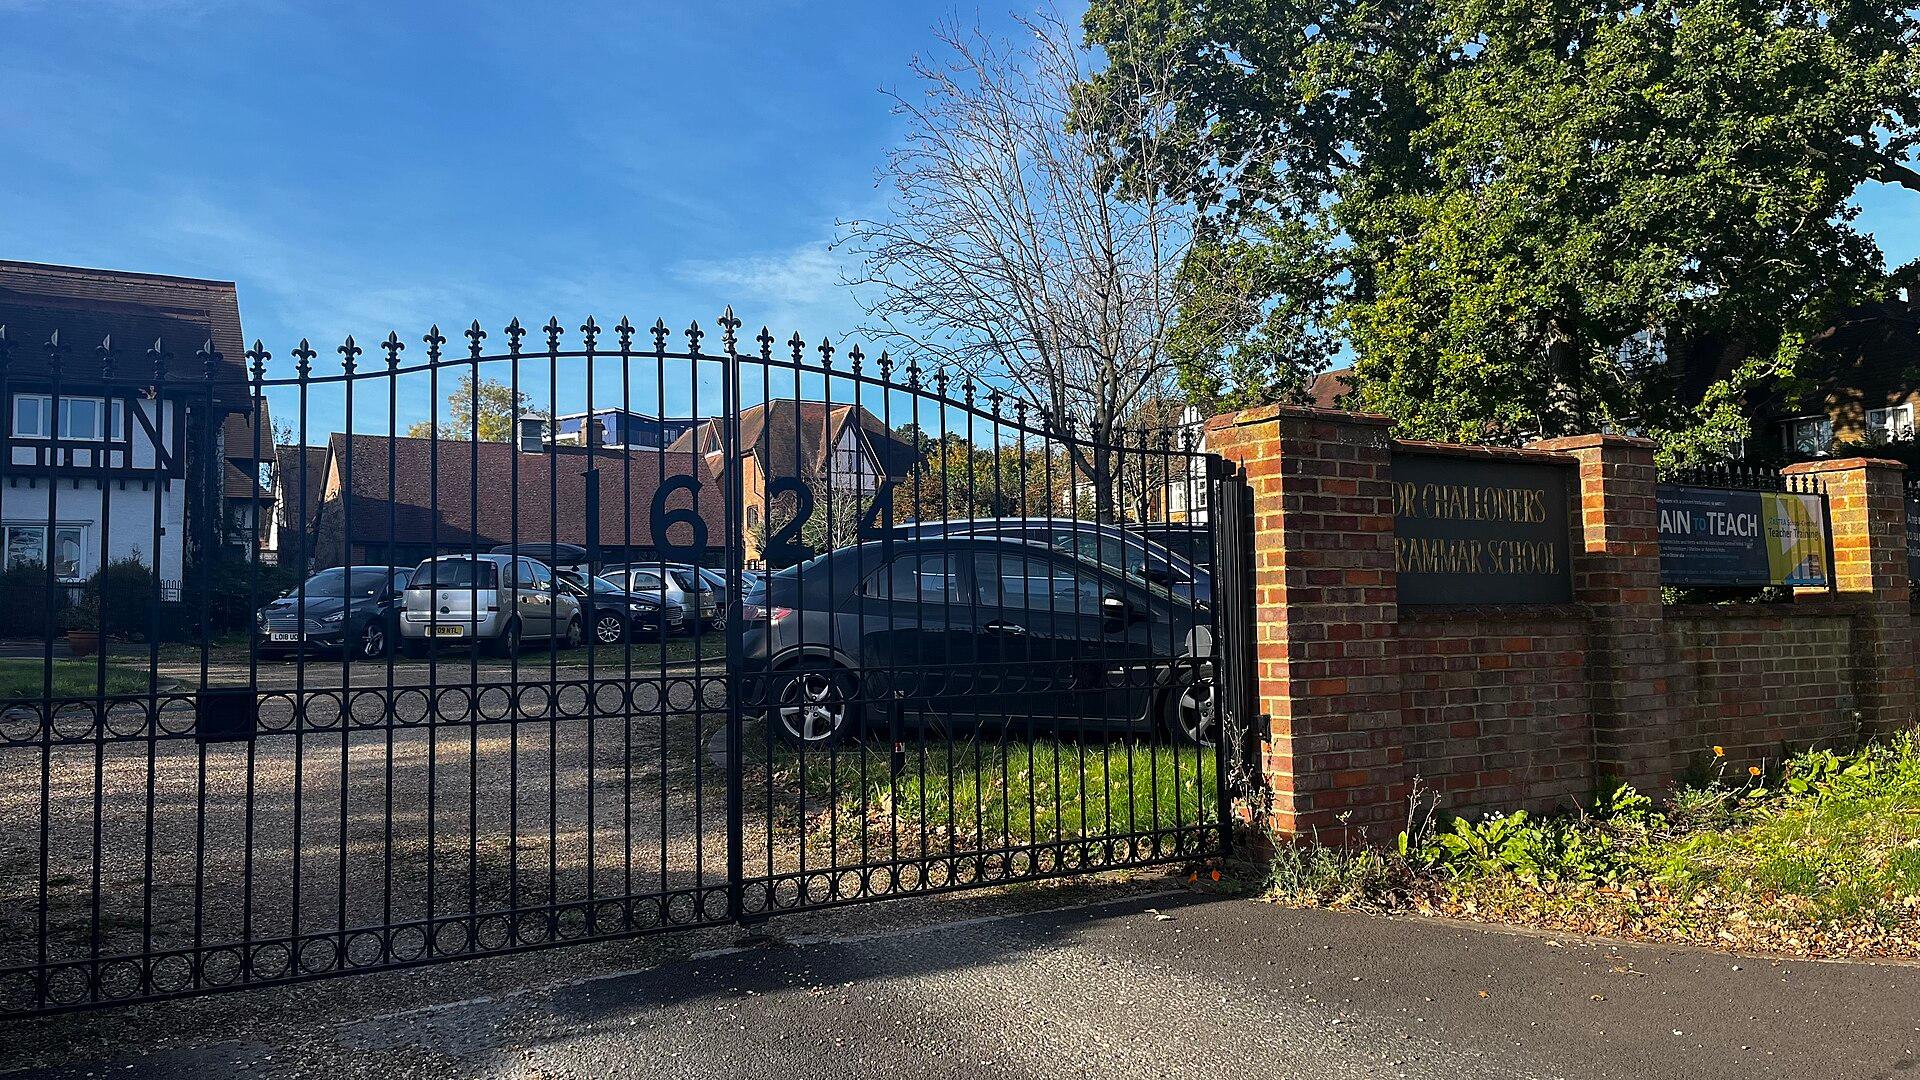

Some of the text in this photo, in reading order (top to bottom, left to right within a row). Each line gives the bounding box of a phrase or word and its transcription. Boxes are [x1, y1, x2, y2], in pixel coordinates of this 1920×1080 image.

[1391, 481, 1546, 523] DR CHALLONERS
[1657, 509, 1758, 537] AIN TO TEACH
[1768, 528, 1819, 541] Teacher Training
[1394, 537, 1560, 575] RAMMAR SCHOOL
